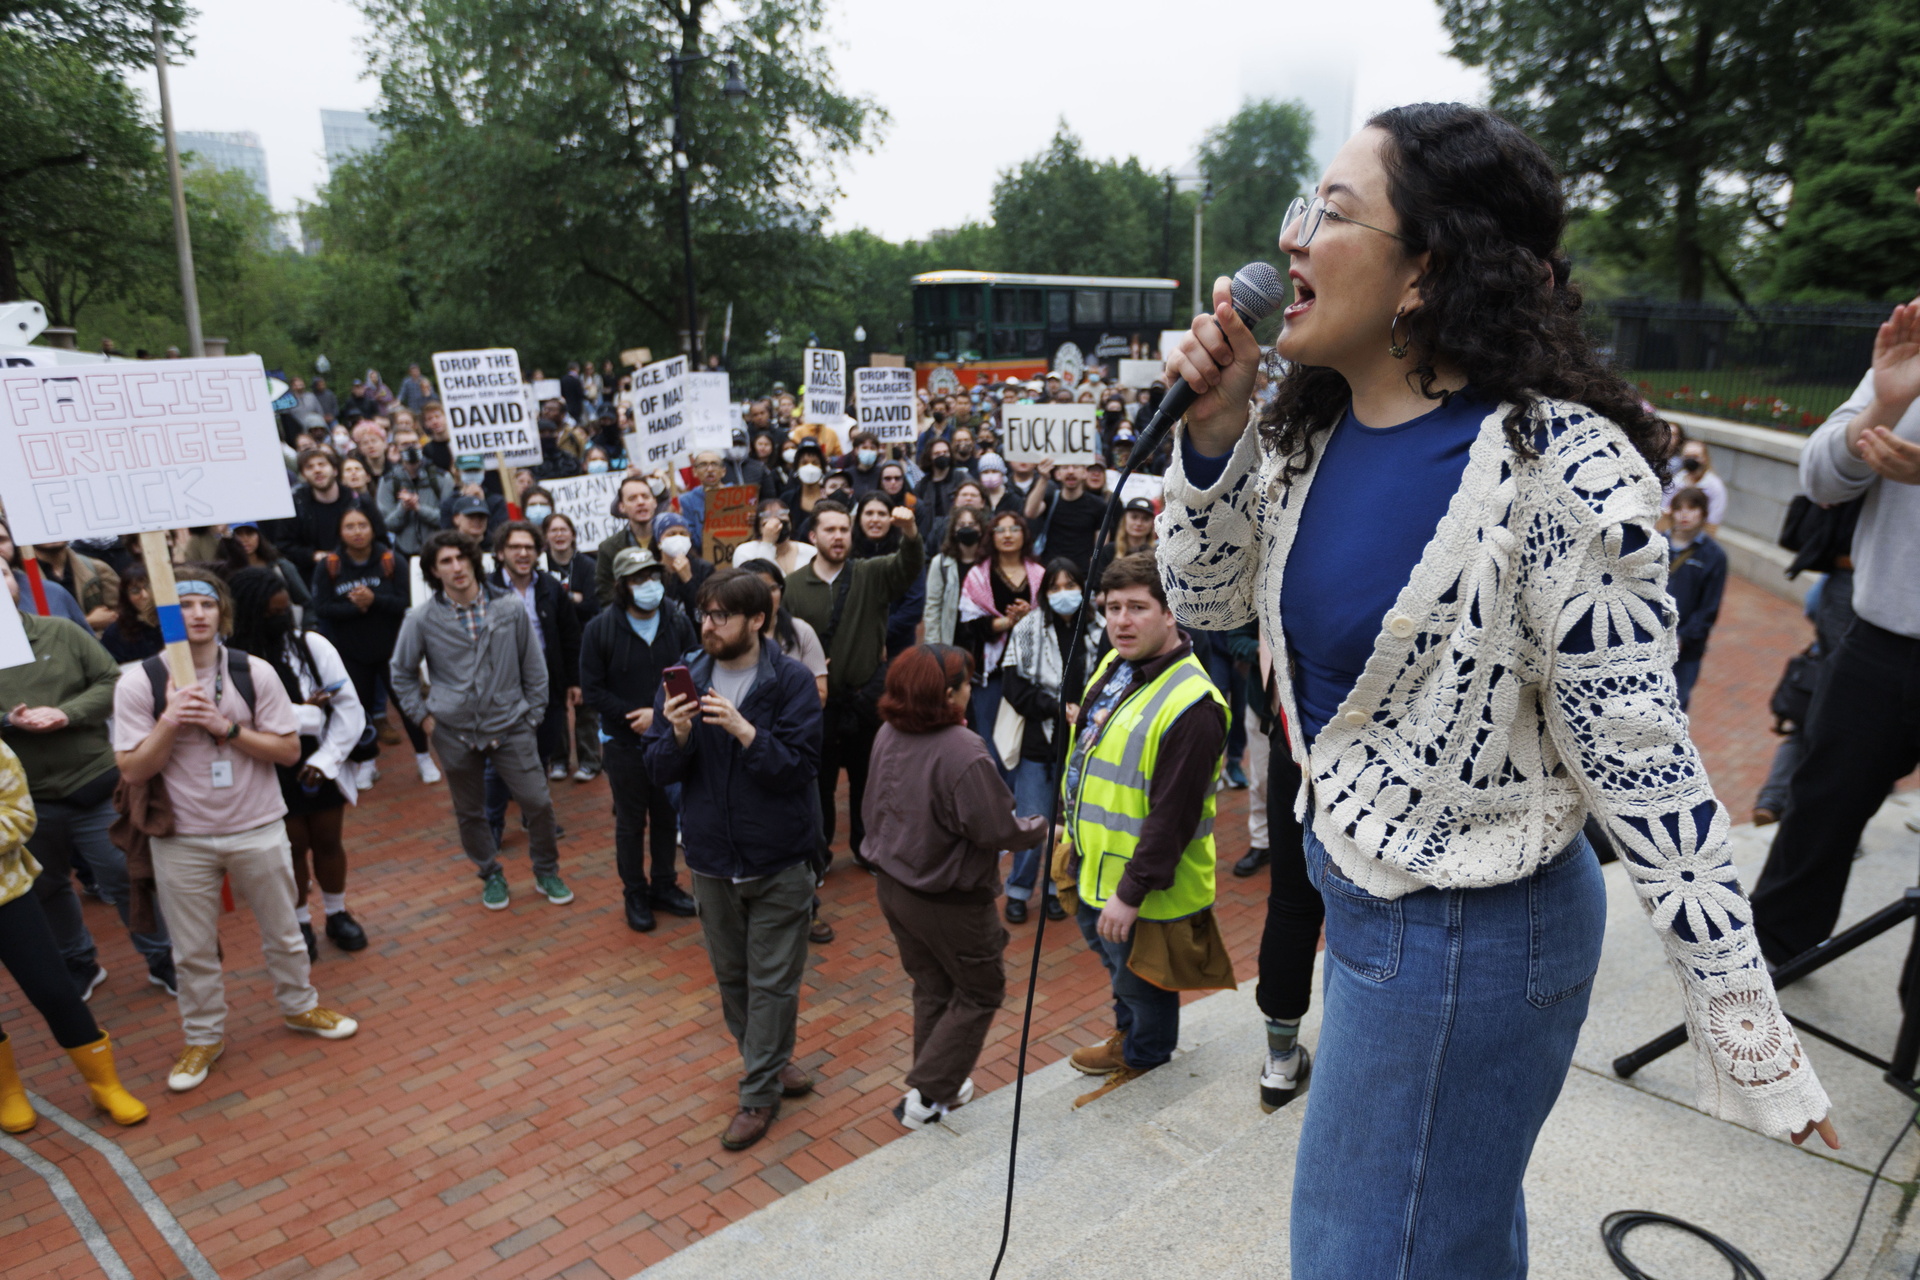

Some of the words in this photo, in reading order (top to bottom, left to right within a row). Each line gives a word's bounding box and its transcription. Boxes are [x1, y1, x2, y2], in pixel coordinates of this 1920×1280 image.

[440, 357, 480, 373] DROP
[486, 354, 514, 368] THE
[665, 361, 683, 380] OUT
[813, 352, 839, 372] END
[443, 372, 518, 390] CHARGES
[811, 372, 842, 387] MASS
[860, 371, 888, 380] DROP
[891, 371, 912, 381] THE
[4, 369, 262, 426] FASCIST
[860, 383, 913, 394] CHARGES
[641, 395, 659, 416] OF
[663, 386, 684, 409] MA!
[811, 400, 841, 416] NOW!
[450, 402, 524, 428] DAVID
[648, 412, 684, 434] HANDS
[862, 405, 912, 422] DAVID
[456, 429, 529, 451] HUERTA
[1008, 418, 1056, 453] FUCK
[1062, 419, 1093, 453] ICE
[19, 421, 247, 479] ORANGE
[648, 444, 669, 462] OFF
[671, 436, 687, 455] LA!
[32, 467, 214, 535] FUCK
[713, 485, 757, 509] STOP
[561, 499, 607, 519] MAKE
